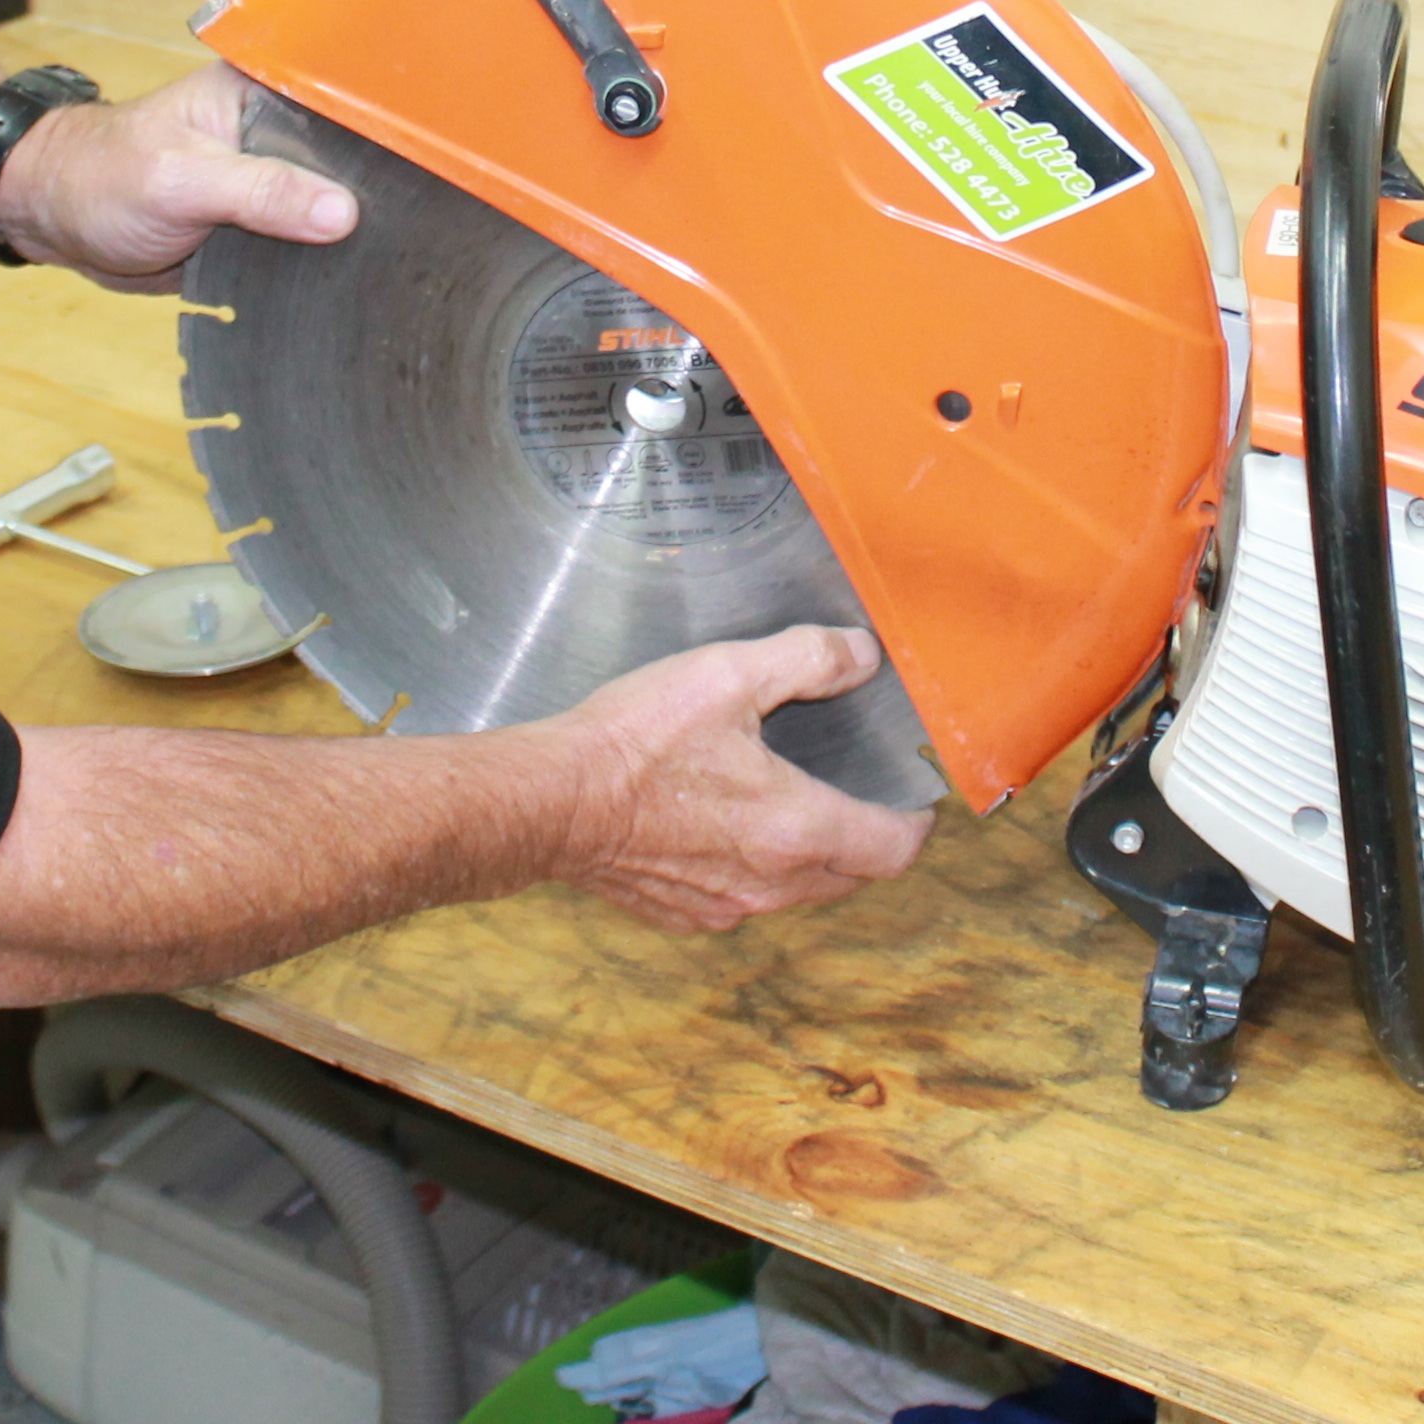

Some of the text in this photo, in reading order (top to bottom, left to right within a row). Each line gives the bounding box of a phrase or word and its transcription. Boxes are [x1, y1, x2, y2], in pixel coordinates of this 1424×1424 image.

[933, 33, 984, 78] Upper
[862, 72, 1021, 221] Phone: 528 4473
[915, 79, 1031, 187] your local hire company
[1001, 110, 1096, 198] Hire
[598, 325, 686, 352] STIHL
